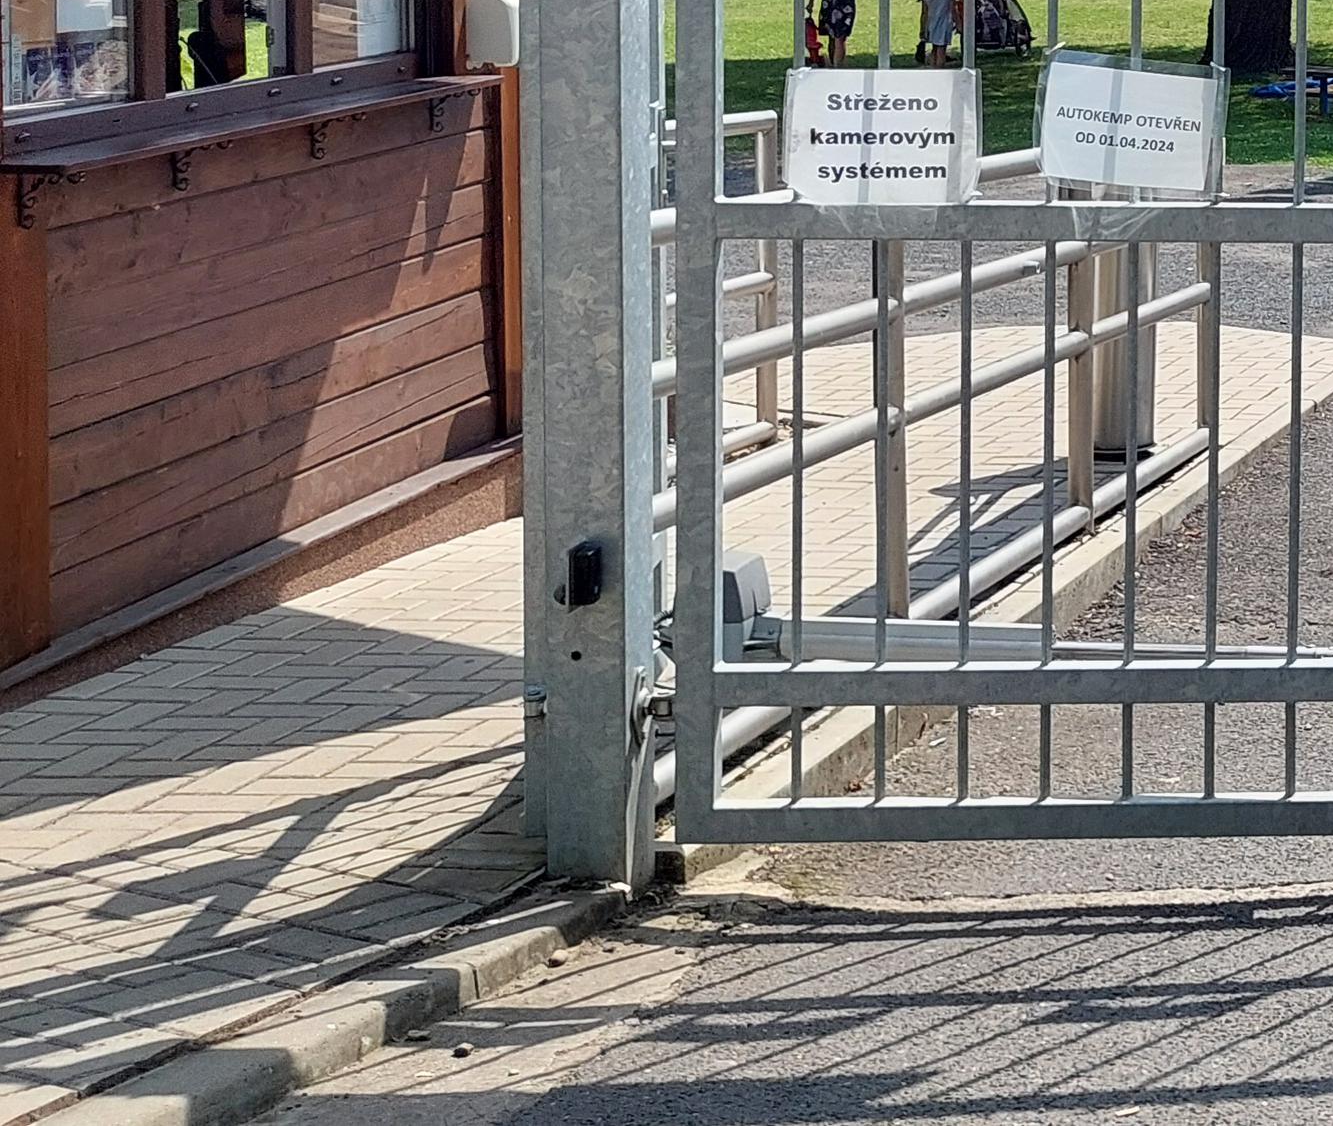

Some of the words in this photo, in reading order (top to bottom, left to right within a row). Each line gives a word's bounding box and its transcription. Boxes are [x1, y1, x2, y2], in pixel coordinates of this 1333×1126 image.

[827, 93, 939, 111] Střeženo
[1056, 105, 1133, 126] AUTOKEMP
[1135, 115, 1202, 133] OTEVŘEN
[810, 127, 956, 149] kamerovým
[1075, 131, 1096, 144] OD
[1099, 134, 1175, 153] 01.04.2024
[817, 161, 947, 184] systémem
